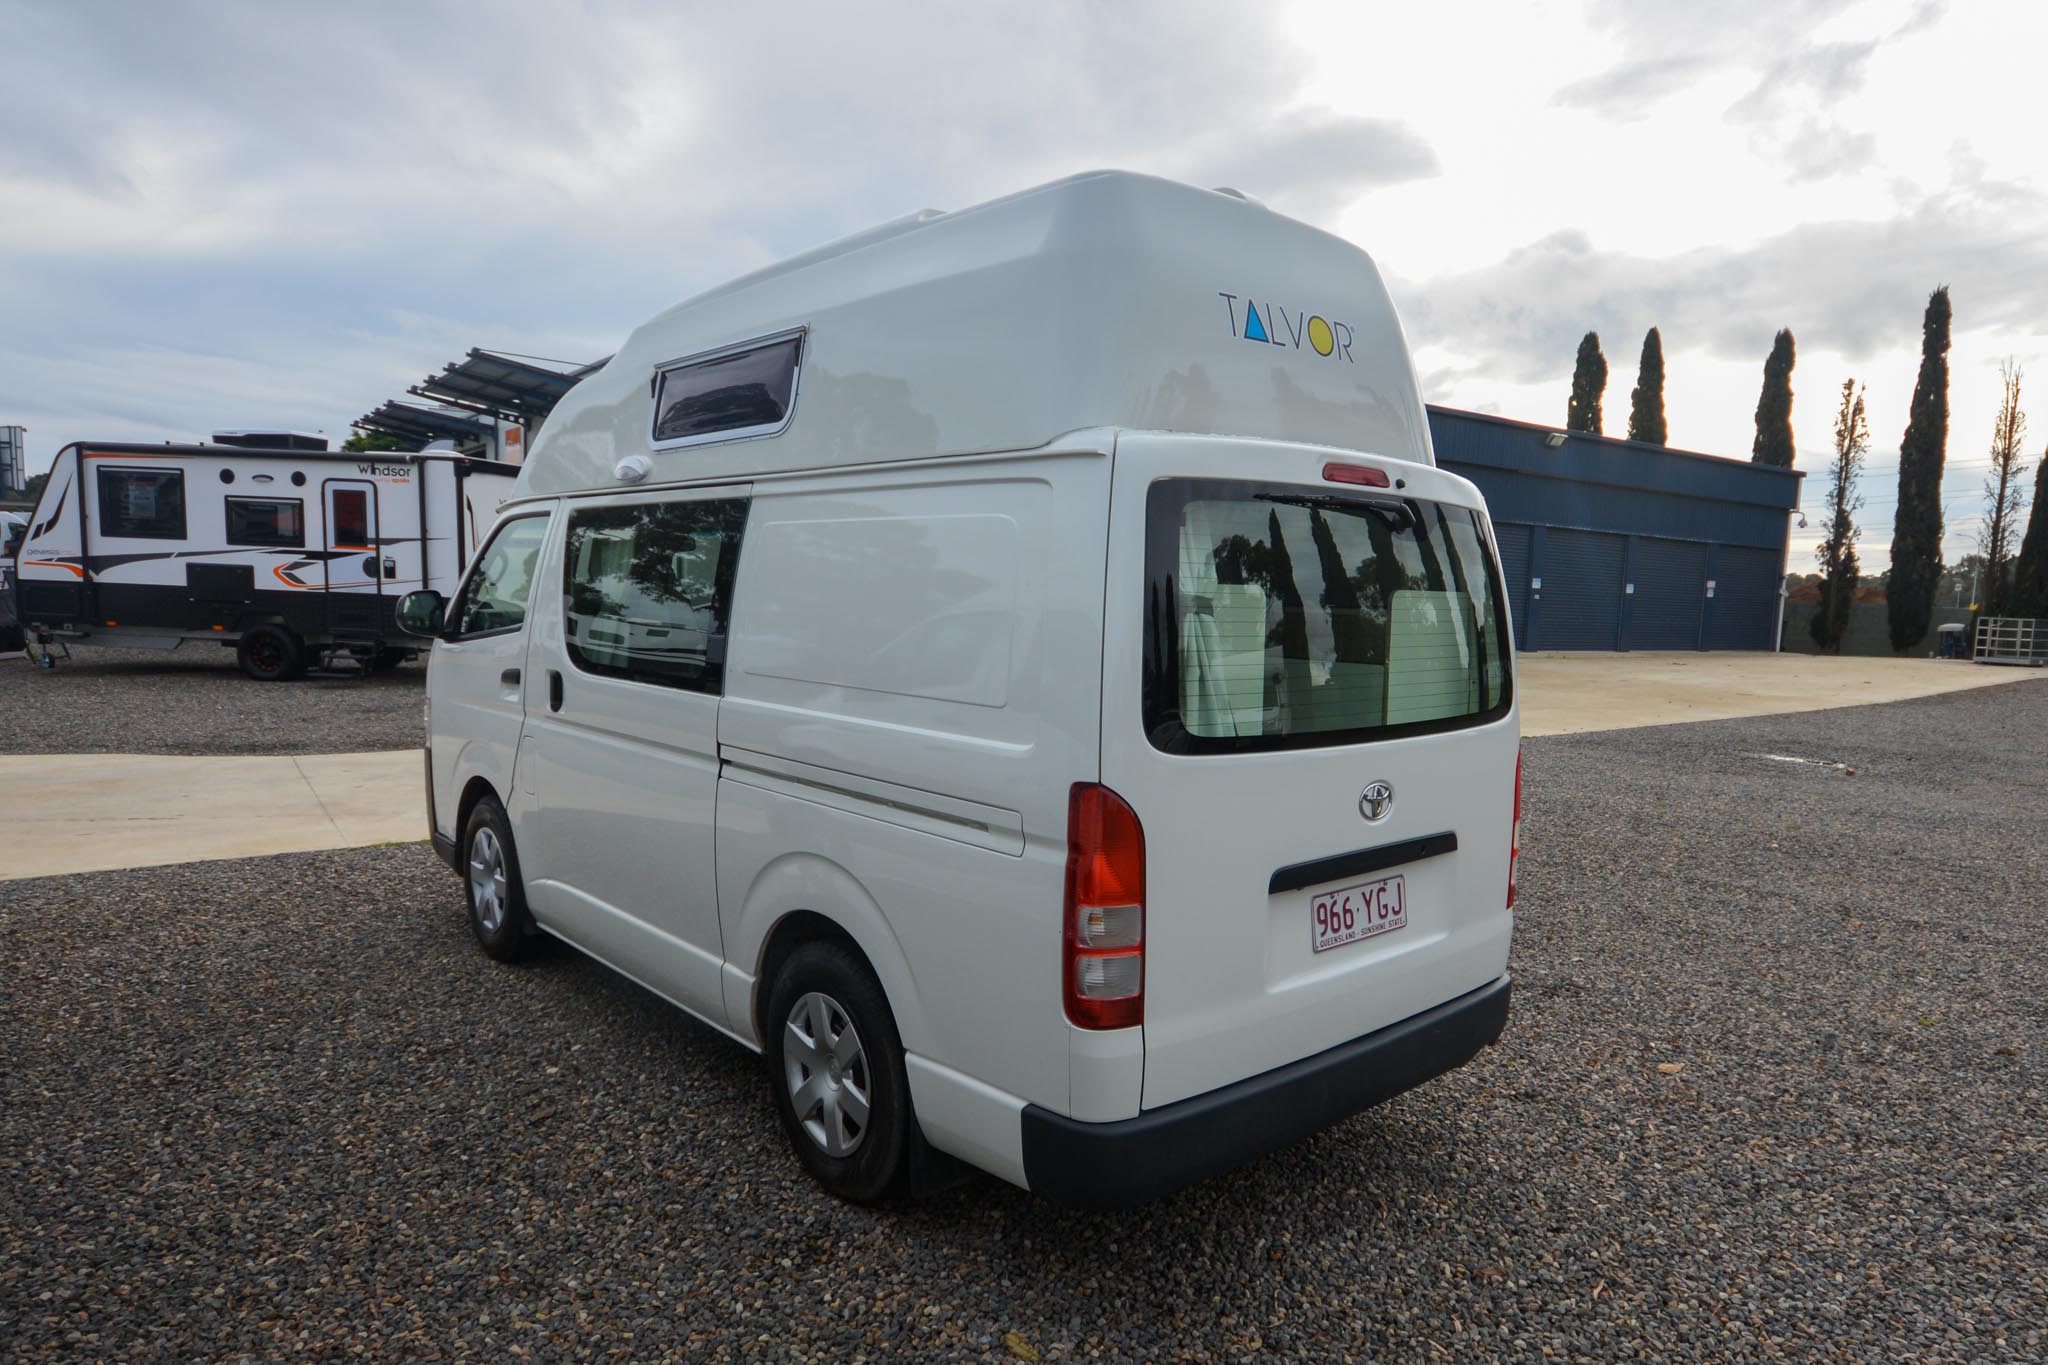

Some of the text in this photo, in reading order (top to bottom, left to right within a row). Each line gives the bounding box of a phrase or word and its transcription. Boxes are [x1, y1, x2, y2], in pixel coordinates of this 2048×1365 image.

[1218, 292, 1354, 364] TALVOR
[357, 464, 411, 477] Windsor
[1319, 917, 1403, 948] QUEENSLAND SUNSHINE STATE
